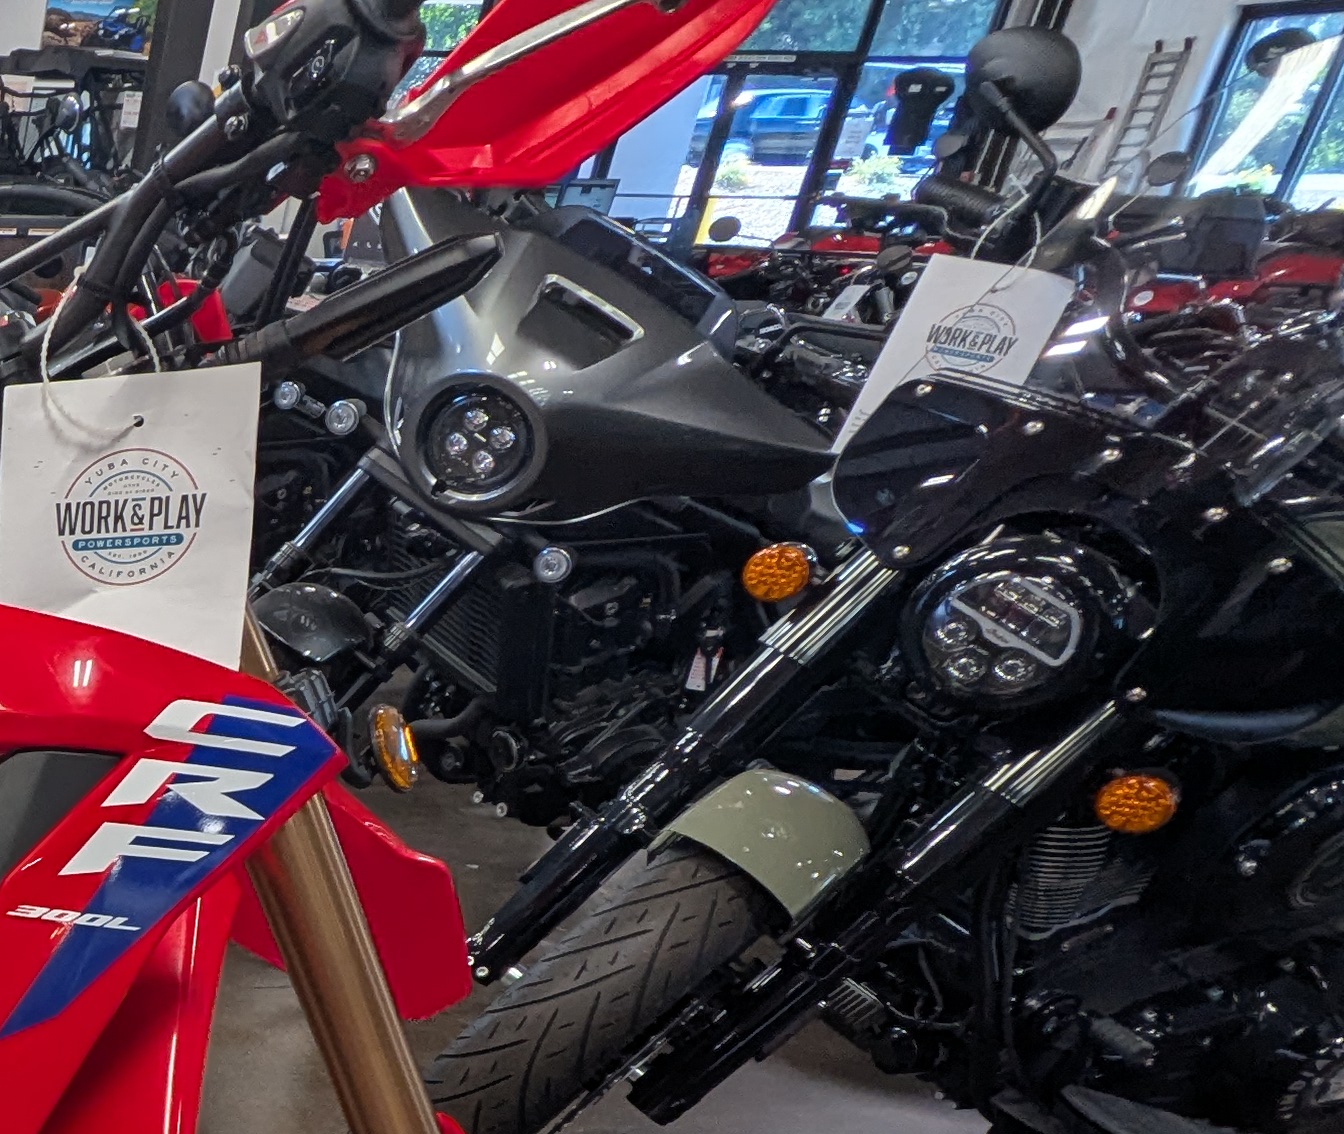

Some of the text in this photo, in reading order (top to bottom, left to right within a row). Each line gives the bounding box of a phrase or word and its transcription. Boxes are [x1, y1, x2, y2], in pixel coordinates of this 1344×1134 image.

[85, 457, 180, 486] YUBA CITY
[78, 535, 178, 549] POWERSPORTS
[81, 551, 175, 578] CALIFORNIA
[57, 699, 308, 876] CRF
[6, 904, 141, 931] 300L
